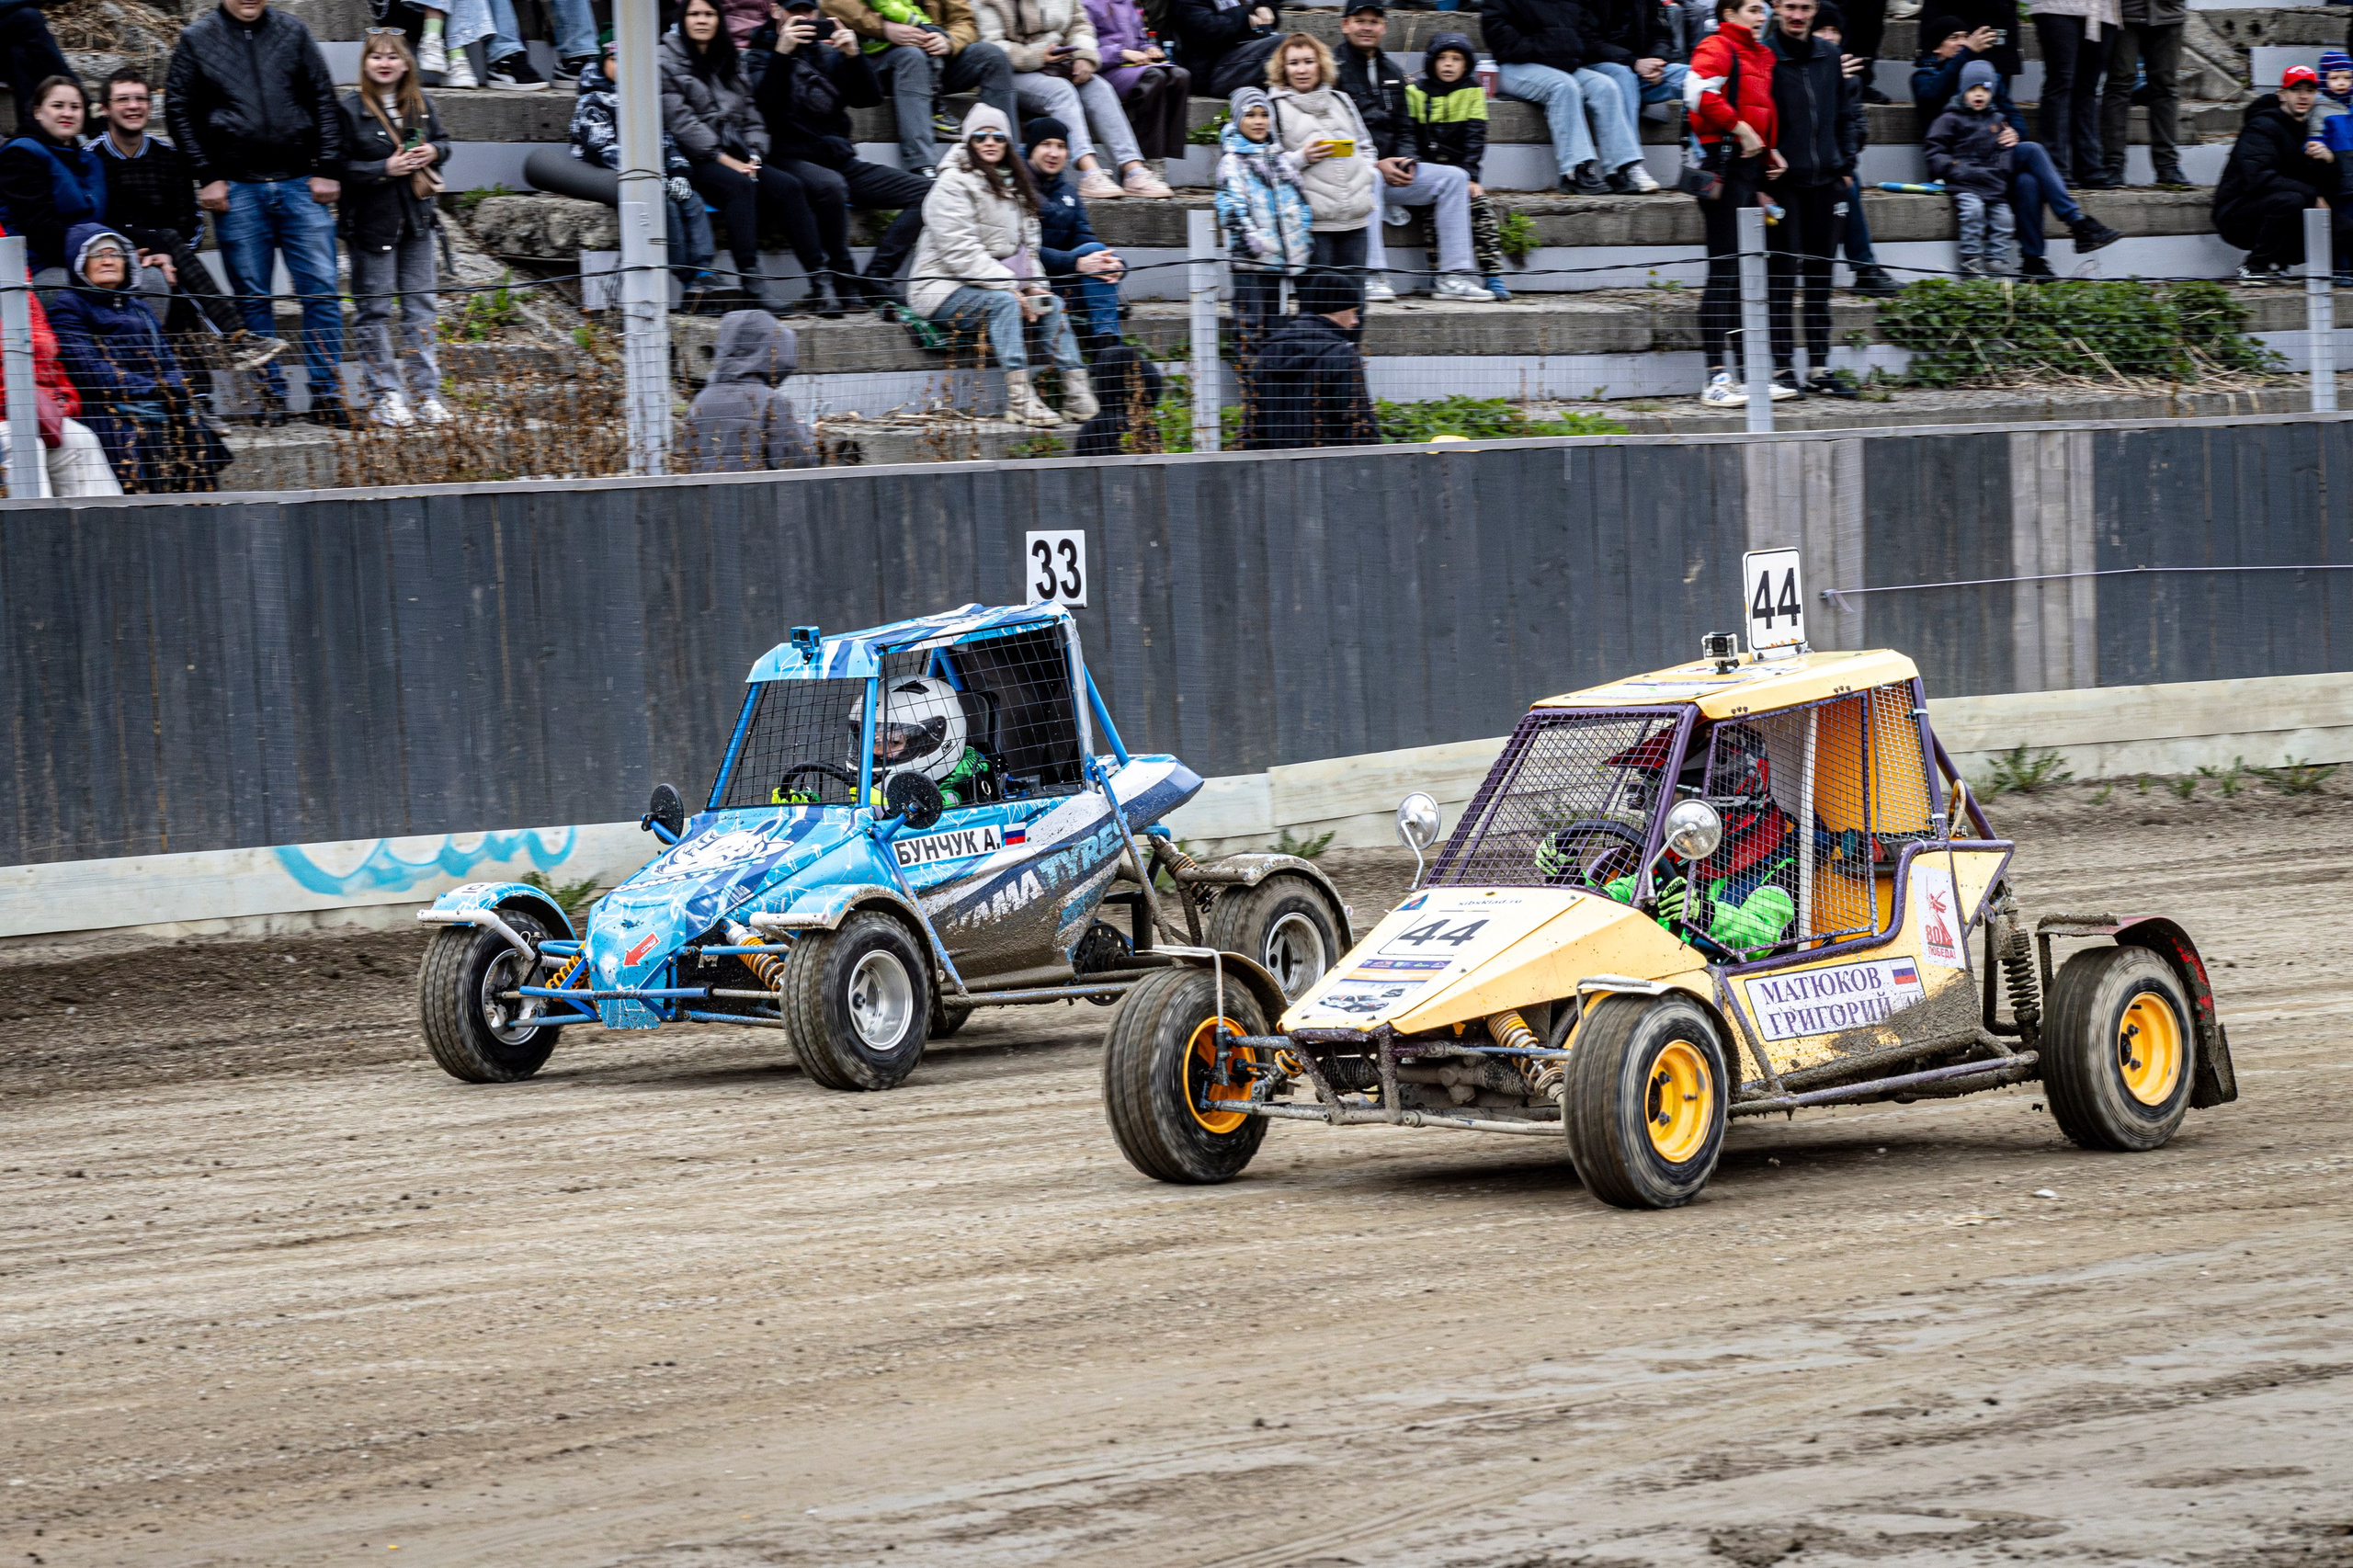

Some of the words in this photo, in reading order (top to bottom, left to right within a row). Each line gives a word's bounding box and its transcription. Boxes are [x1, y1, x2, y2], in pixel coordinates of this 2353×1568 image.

[1031, 538, 1082, 600] 33
[1752, 567, 1802, 630] 44
[893, 830, 979, 866] БУНЧУК
[983, 828, 1001, 851] А.
[1666, 879, 1683, 893] THOR
[1397, 919, 1491, 947] 44
[1926, 925, 1941, 945] 80
[1928, 946, 1957, 960] ПОБЕДА!
[1759, 967, 1882, 1005] МАТЮКОВ
[1768, 993, 1893, 1036] ГРИГОРИЙ
